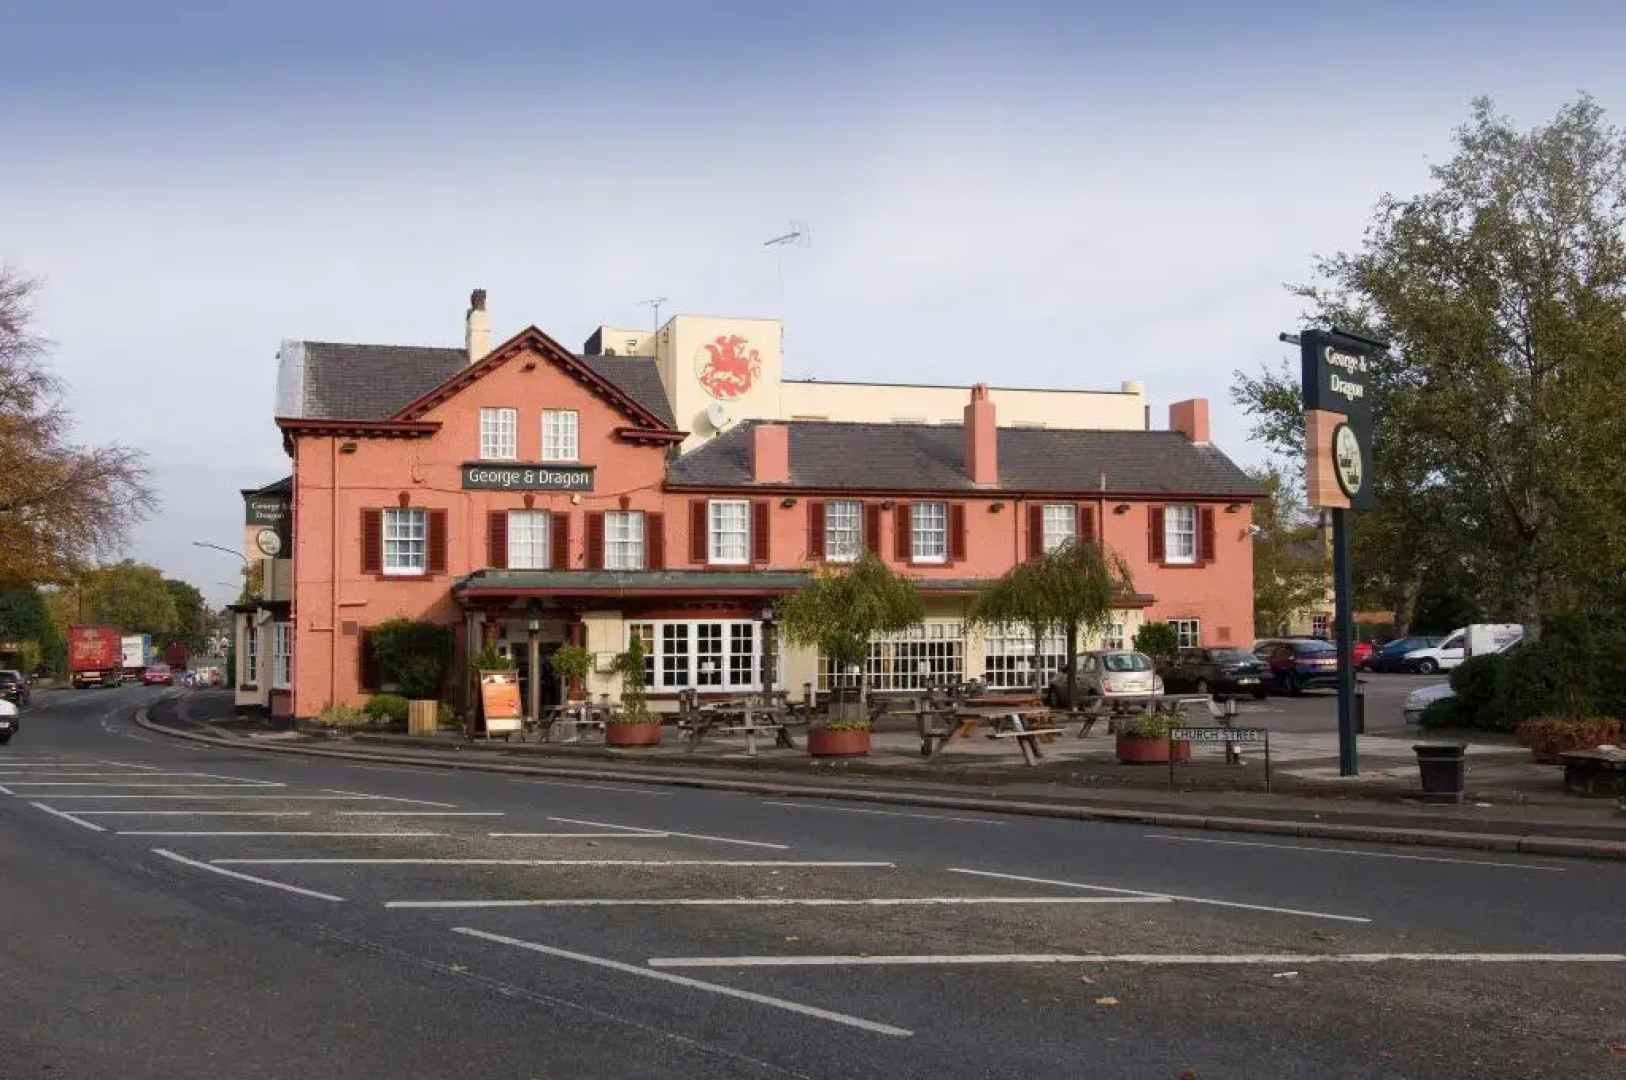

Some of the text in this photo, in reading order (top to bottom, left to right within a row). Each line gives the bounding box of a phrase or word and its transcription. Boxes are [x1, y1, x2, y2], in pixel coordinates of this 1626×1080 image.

[1325, 345, 1359, 375] George
[1331, 374, 1364, 401] Dragon
[469, 468, 589, 488] George & Dragon
[1174, 729, 1262, 741] CHURCH STREE
